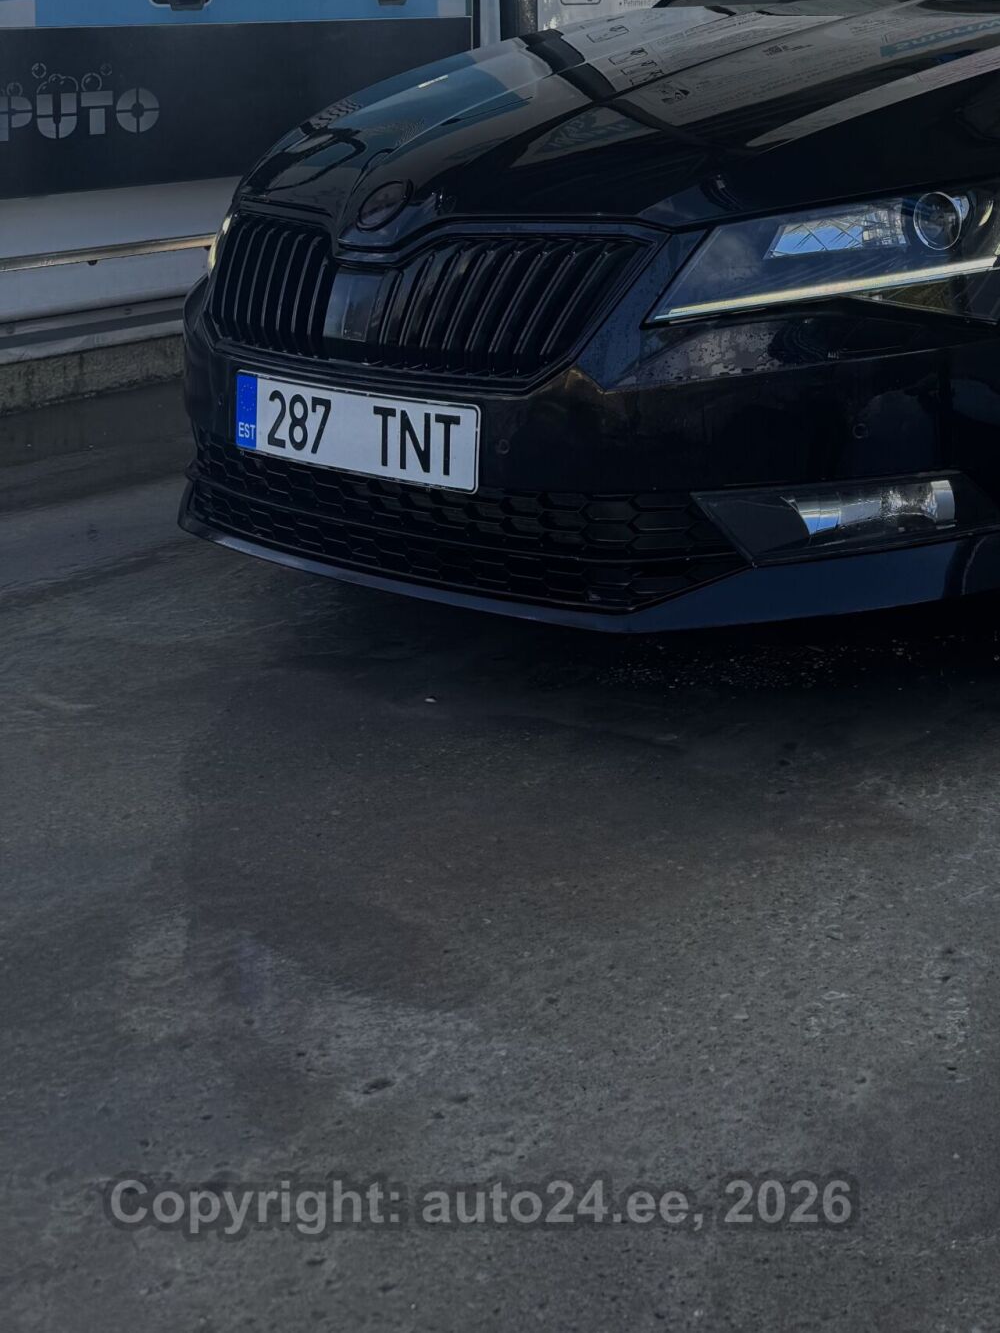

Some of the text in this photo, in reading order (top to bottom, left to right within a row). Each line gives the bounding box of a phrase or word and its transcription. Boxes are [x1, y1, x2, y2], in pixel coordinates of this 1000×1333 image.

[238, 422, 256, 440] EST
[267, 390, 461, 476] 287 TNT
